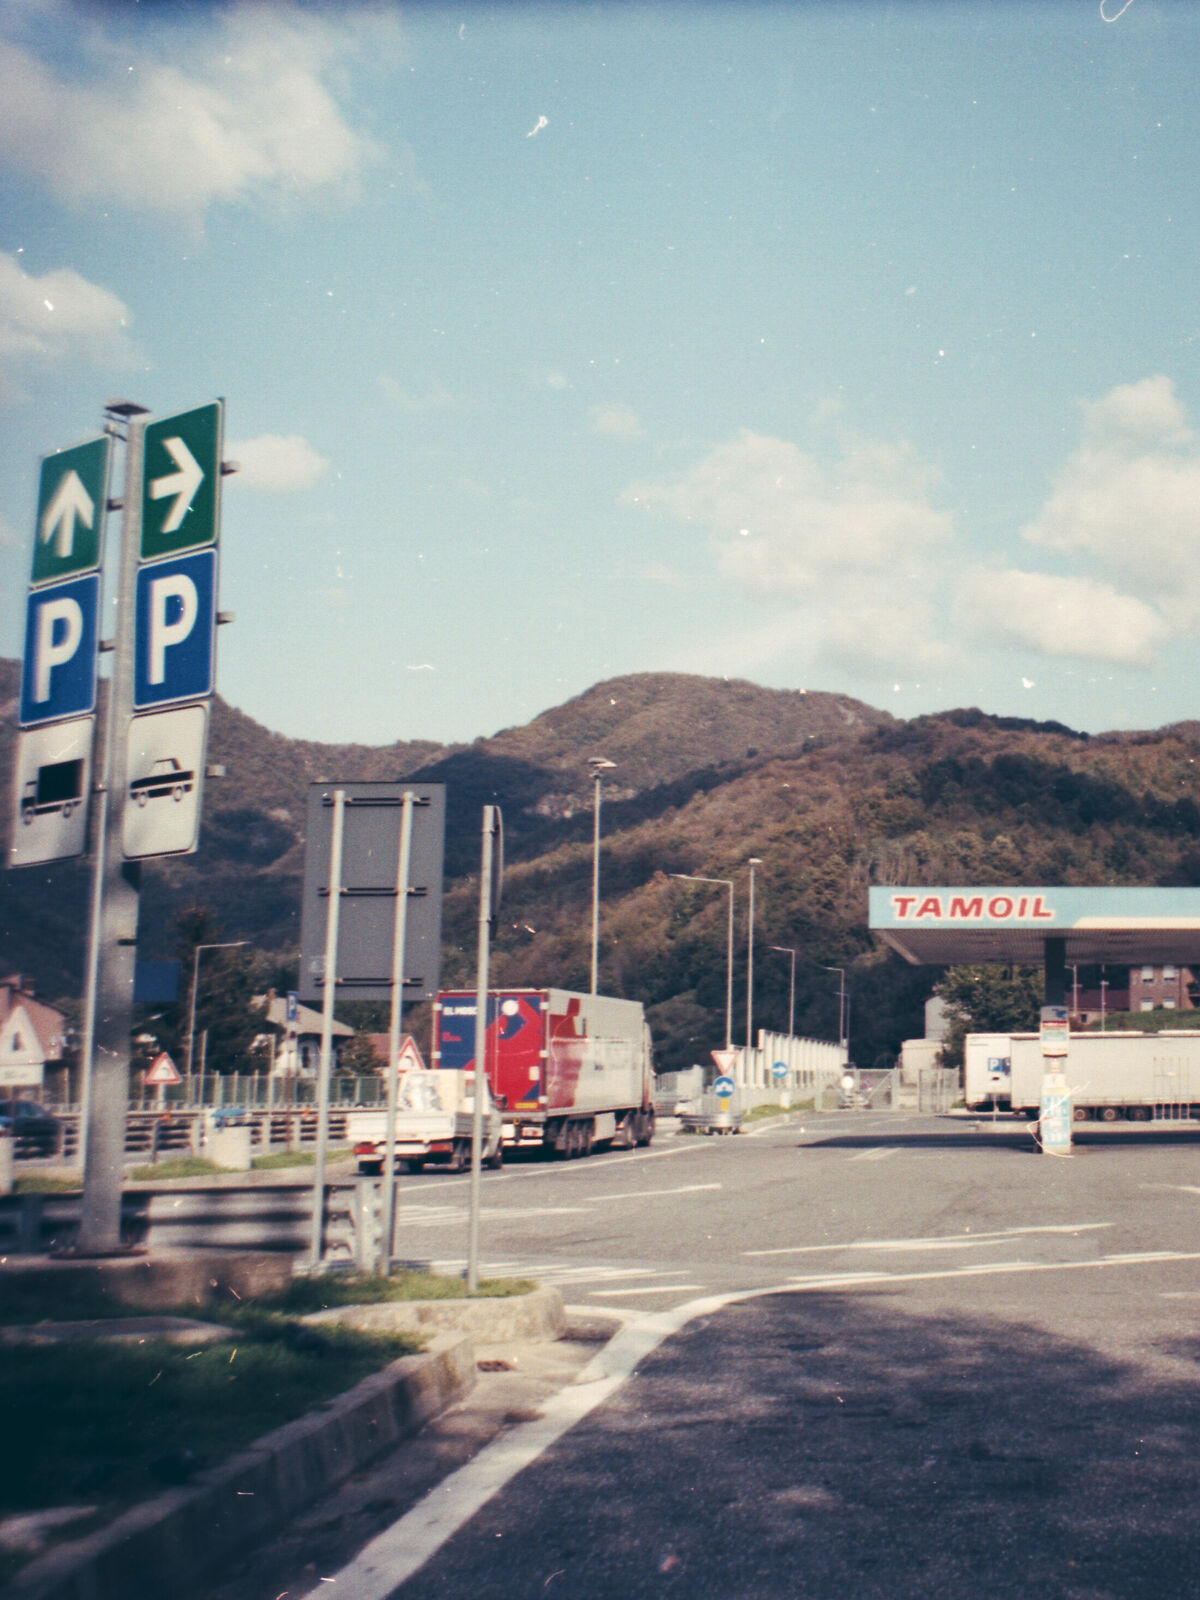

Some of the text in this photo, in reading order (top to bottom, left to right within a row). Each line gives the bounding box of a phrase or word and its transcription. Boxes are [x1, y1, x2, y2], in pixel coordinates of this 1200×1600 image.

[34, 597, 83, 703] P
[149, 573, 198, 685] P
[893, 897, 1052, 918] TAMOIL
